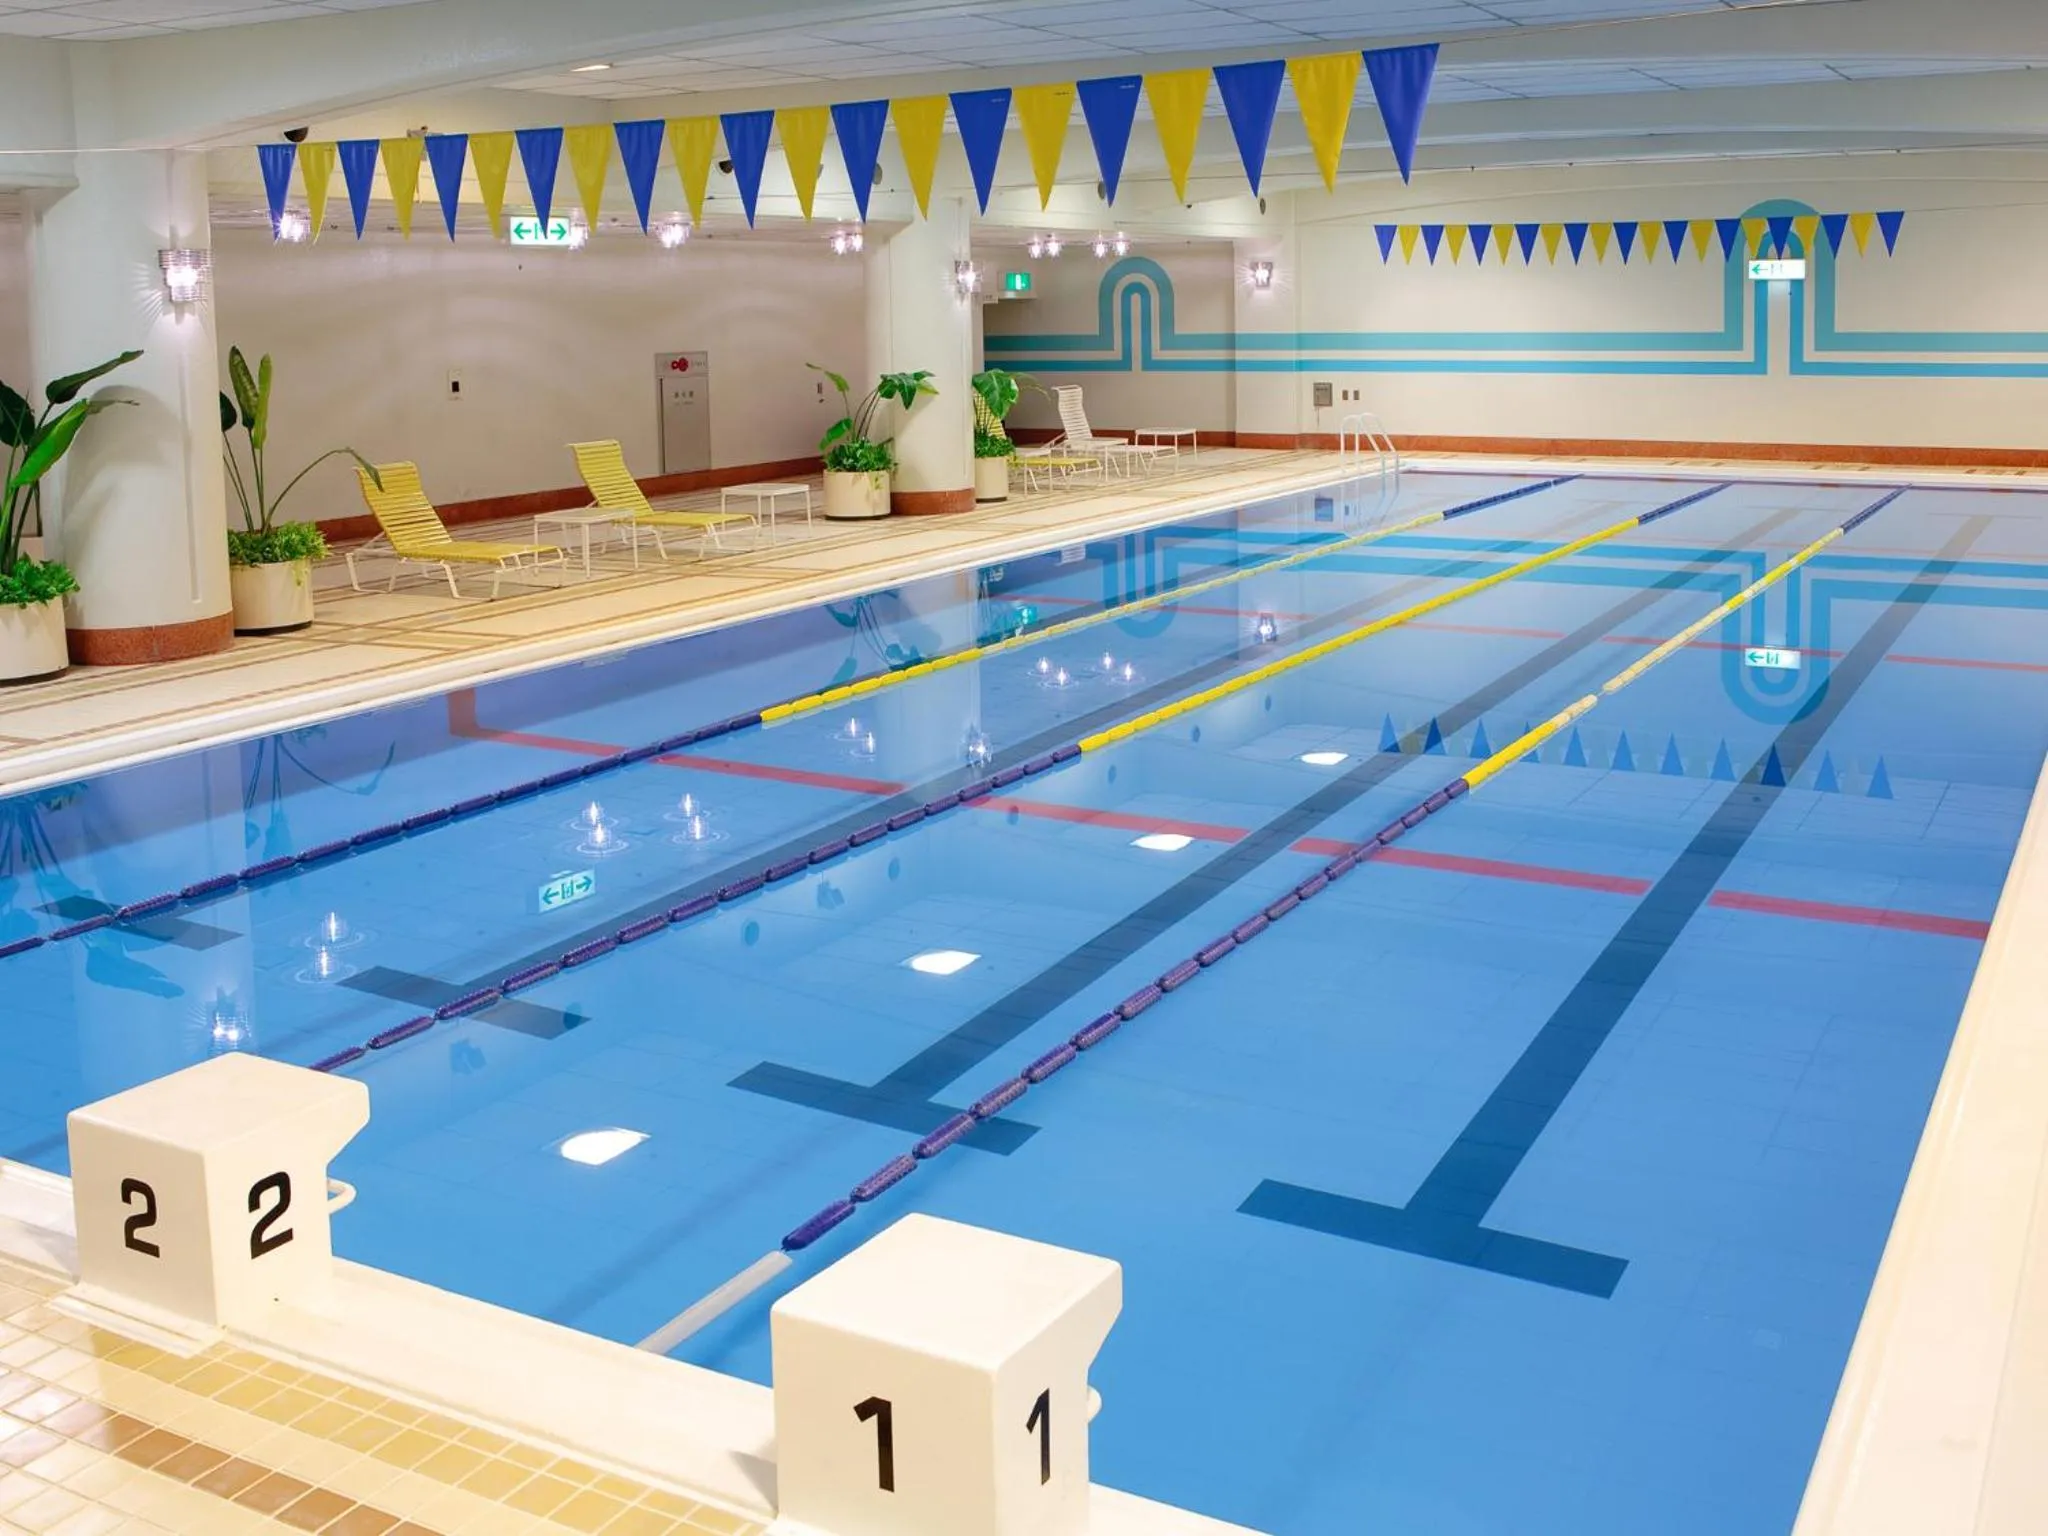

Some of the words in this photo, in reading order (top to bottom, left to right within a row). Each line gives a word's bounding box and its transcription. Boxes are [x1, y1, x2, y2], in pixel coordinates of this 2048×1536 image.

[120, 1177, 161, 1259] 2
[248, 1171, 294, 1260] 2
[853, 1396, 895, 1493] 1
[1026, 1388, 1051, 1486] 1
